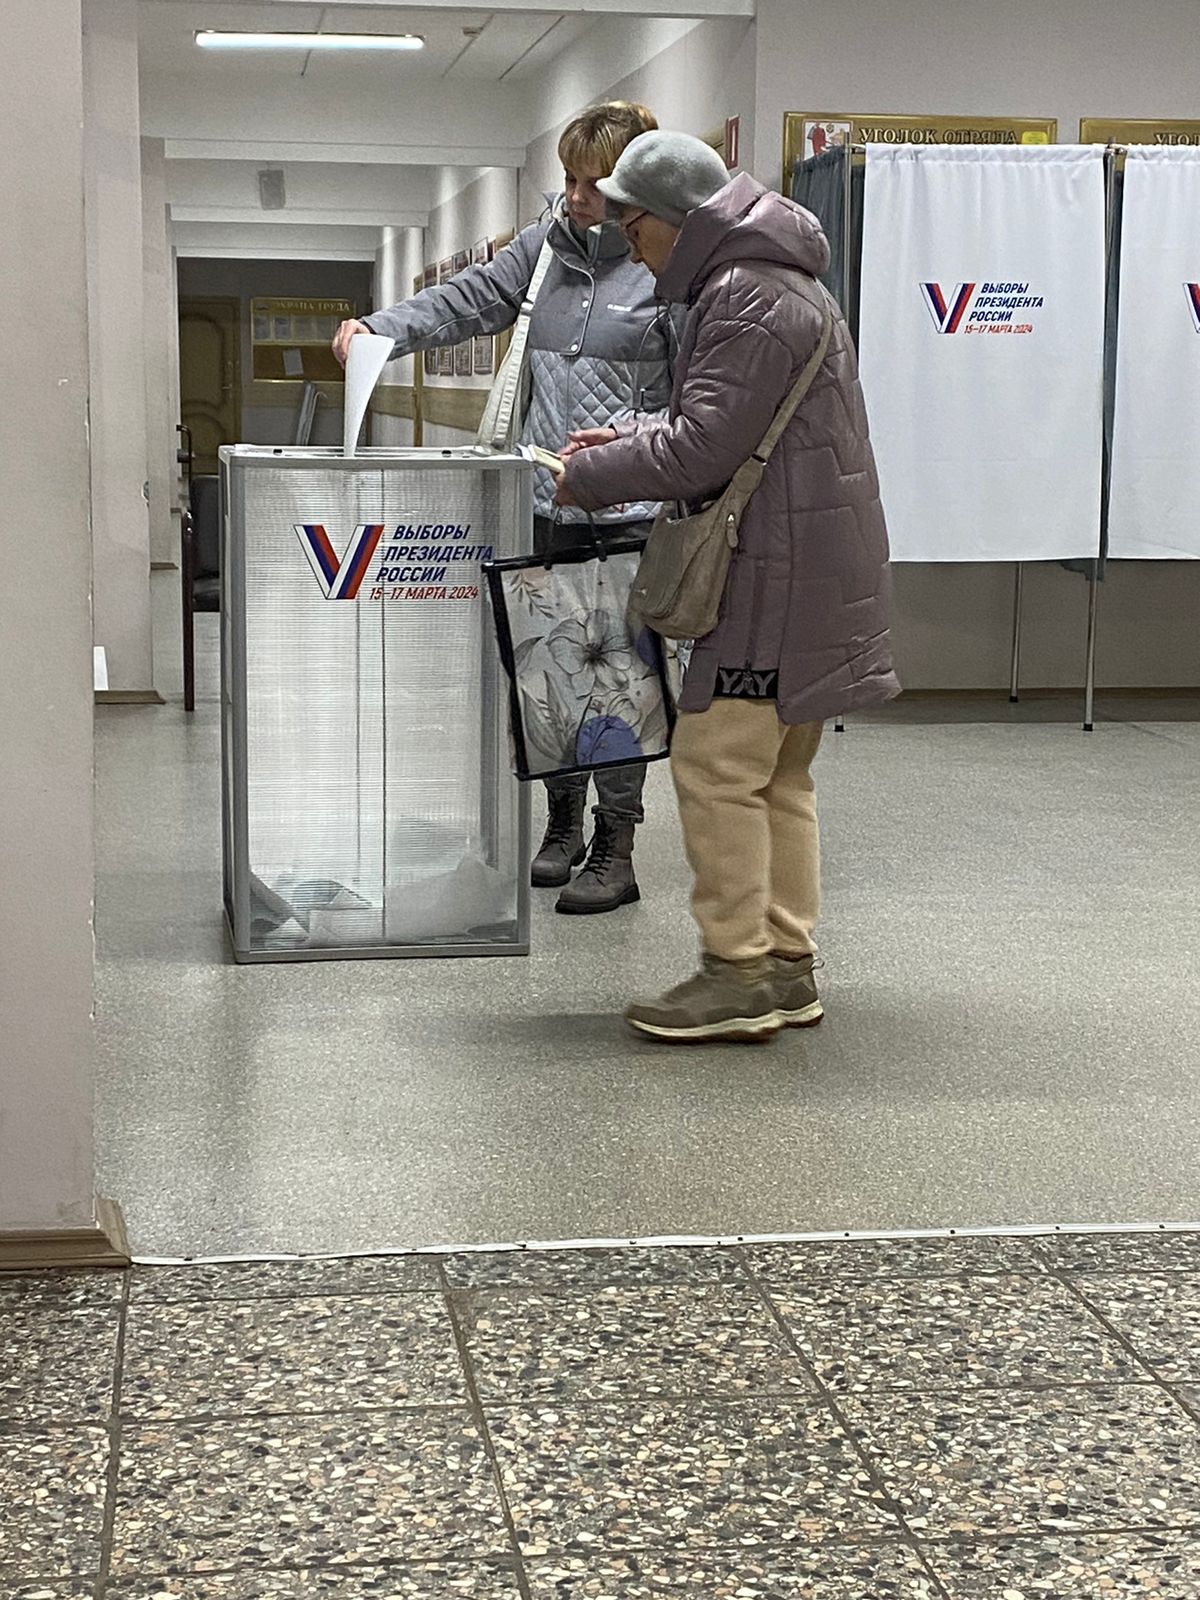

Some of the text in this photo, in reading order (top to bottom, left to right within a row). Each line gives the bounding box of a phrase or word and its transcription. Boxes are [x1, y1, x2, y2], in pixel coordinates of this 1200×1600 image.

[860, 127, 937, 144] УГОЛОК
[981, 283, 1029, 294] ВЫБОРЫ
[975, 297, 1044, 309] ПРЕЗИДЕНТА
[968, 311, 1013, 322] РОССИИ
[987, 325, 1012, 334] МАРТА
[393, 524, 471, 540] ВЫБОРЫ
[383, 545, 493, 563] ПРЕЗИДЕНТА
[375, 566, 447, 583] РОССИИ
[404, 586, 446, 600] МАРТА
[449, 586, 479, 599] 2024
